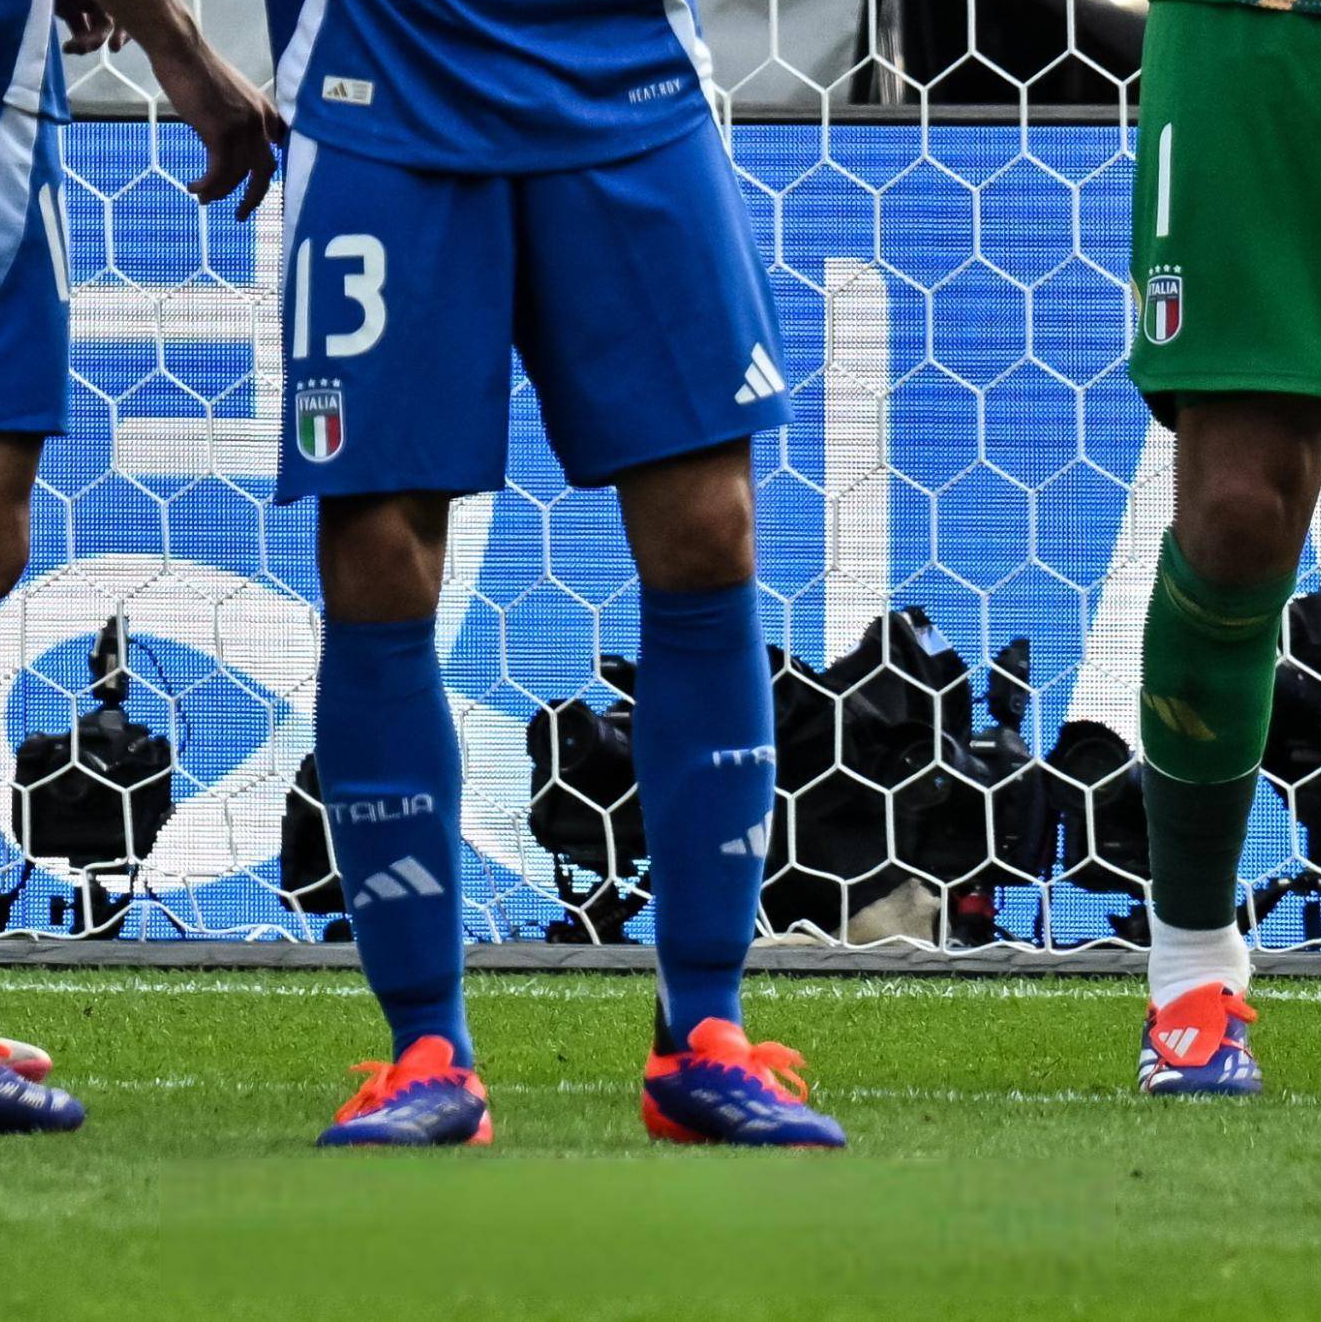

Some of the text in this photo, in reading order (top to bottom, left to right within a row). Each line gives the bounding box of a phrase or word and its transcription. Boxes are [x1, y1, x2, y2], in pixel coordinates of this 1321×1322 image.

[292, 233, 386, 359] 13
[1149, 281, 1179, 296] ITALIA
[299, 395, 338, 411] ITALIA
